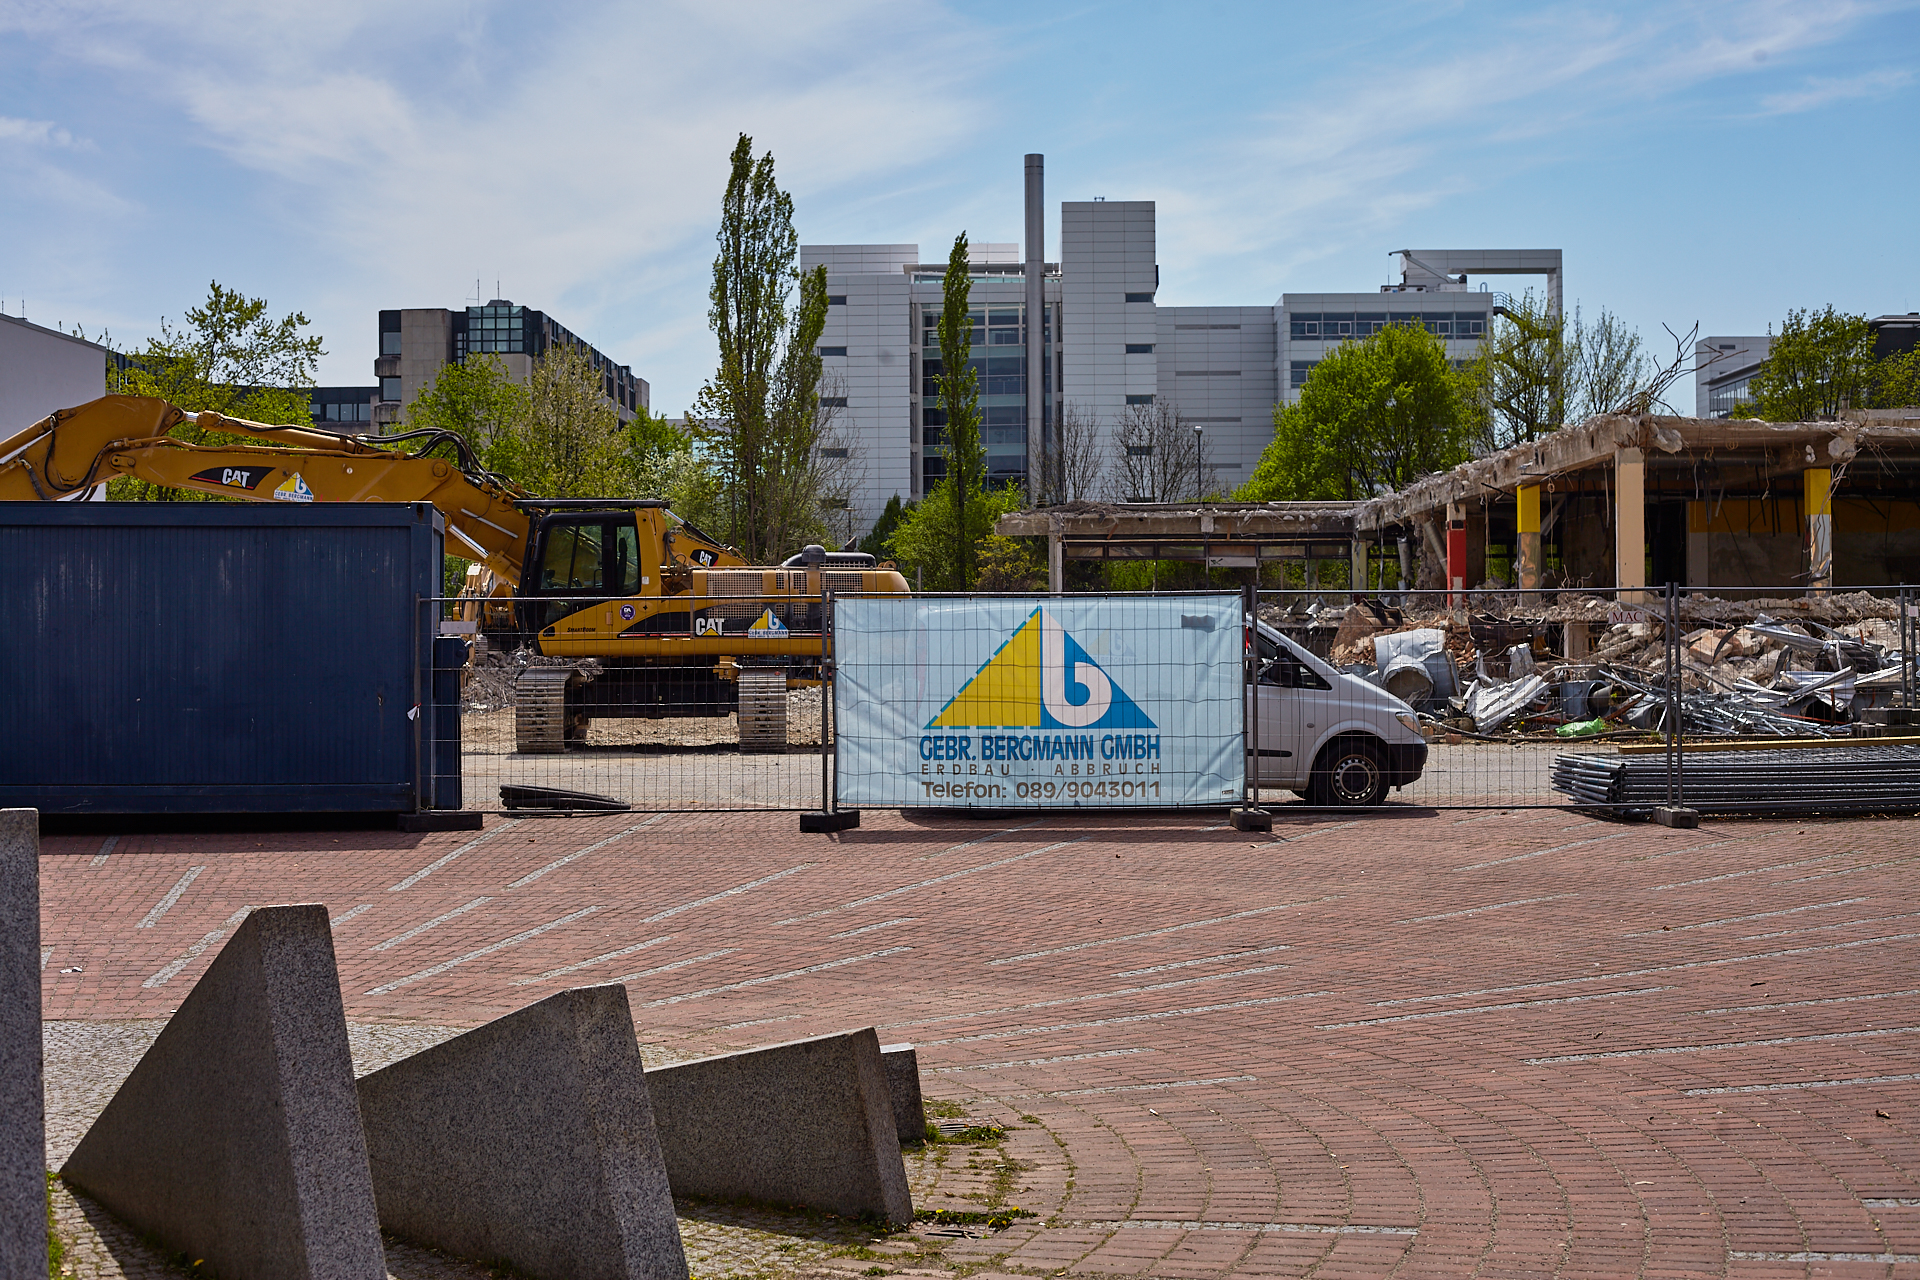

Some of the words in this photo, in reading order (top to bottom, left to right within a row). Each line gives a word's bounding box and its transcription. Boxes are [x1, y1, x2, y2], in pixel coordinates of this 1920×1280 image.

[222, 468, 251, 488] CAT
[699, 550, 713, 567] CAT
[1612, 611, 1643, 622] MAC
[695, 617, 725, 636] CAT
[920, 735, 977, 761] GEBR.
[981, 734, 1094, 761] BERGMANN
[1101, 734, 1160, 760] GMBH
[921, 763, 1010, 776] ERDBAU
[1054, 762, 1160, 776] ABBRUCH
[921, 781, 1007, 799] Telefon:
[1016, 781, 1160, 800] 089/9043011
